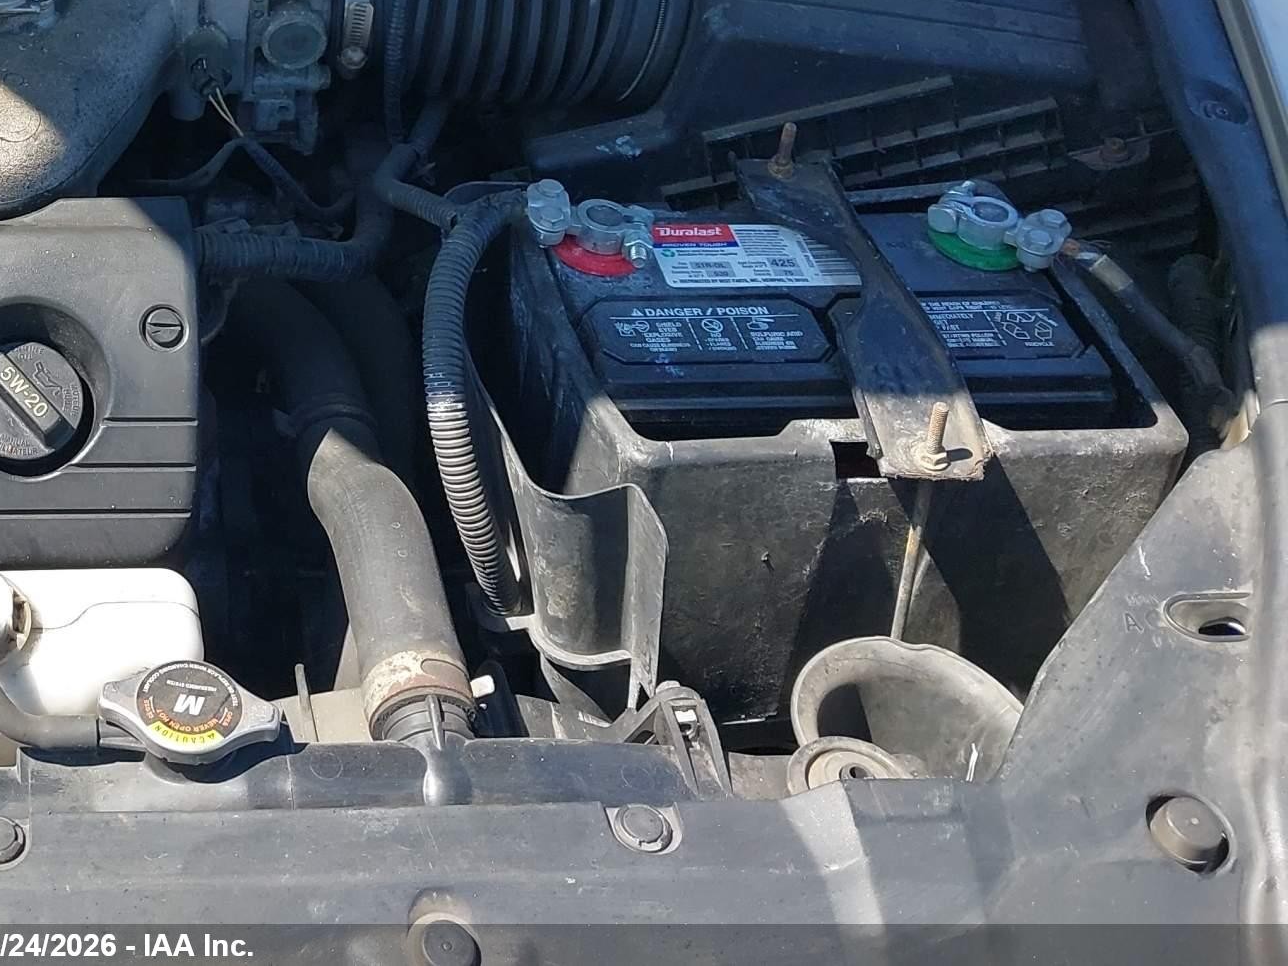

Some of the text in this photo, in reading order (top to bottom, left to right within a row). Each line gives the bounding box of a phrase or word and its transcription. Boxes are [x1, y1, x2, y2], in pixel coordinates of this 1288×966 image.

[656, 226, 723, 237] Duralast
[771, 258, 796, 268] 425
[645, 306, 769, 317] DANGER / POISON
[0, 366, 49, 418] 5W-20
[189, 662, 207, 671] WHEN
[142, 673, 160, 693] COOLANT
[173, 694, 206, 716] M
[156, 708, 219, 732] NEVER OPEN HOT
[155, 724, 205, 744] CAUTION
